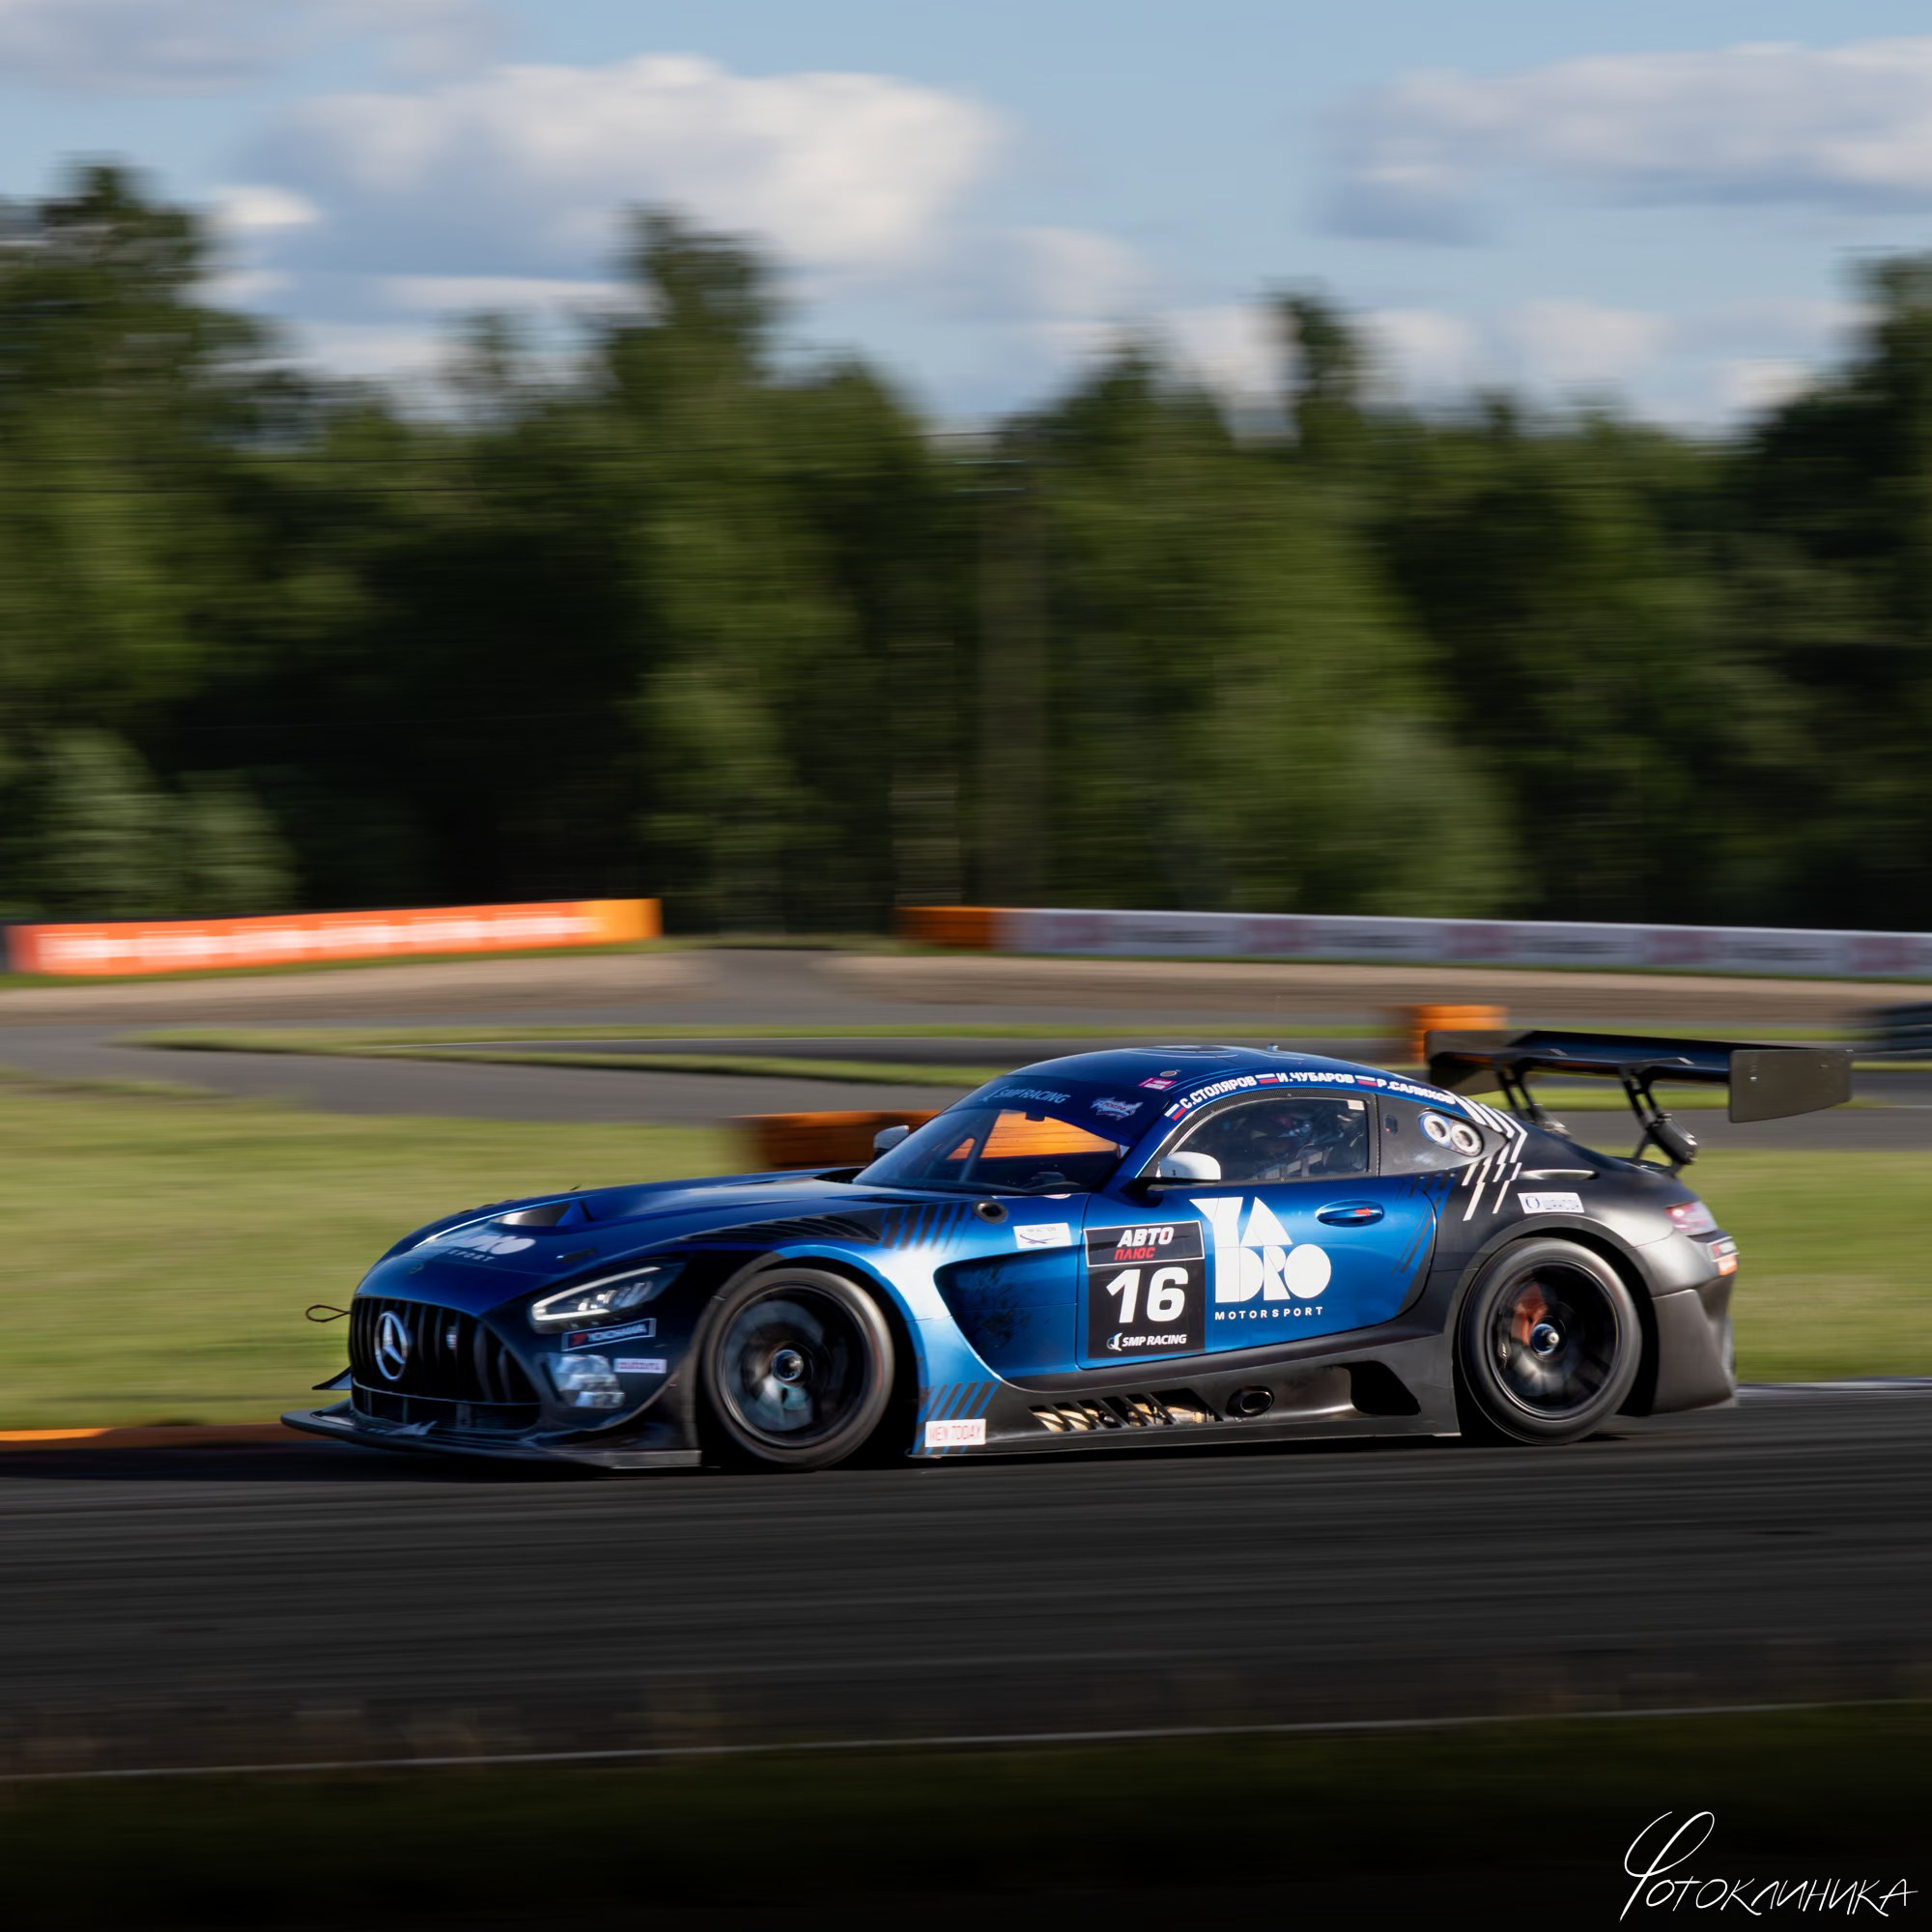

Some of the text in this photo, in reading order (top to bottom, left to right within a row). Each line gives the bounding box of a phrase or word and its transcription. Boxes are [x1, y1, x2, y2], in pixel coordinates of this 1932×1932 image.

[1276, 1072, 1355, 1084] И.ЧУБАРОВ
[1019, 1090, 1070, 1103] RACING
[1179, 1075, 1257, 1109] С.СТОЛЯРОВ
[1117, 1227, 1175, 1248] АВТО
[1114, 1246, 1155, 1261] ПЛЮС
[1106, 1266, 1188, 1323] 16
[1214, 1306, 1323, 1321] MOTORSPORT
[1122, 1333, 1187, 1348] SMP RACING
